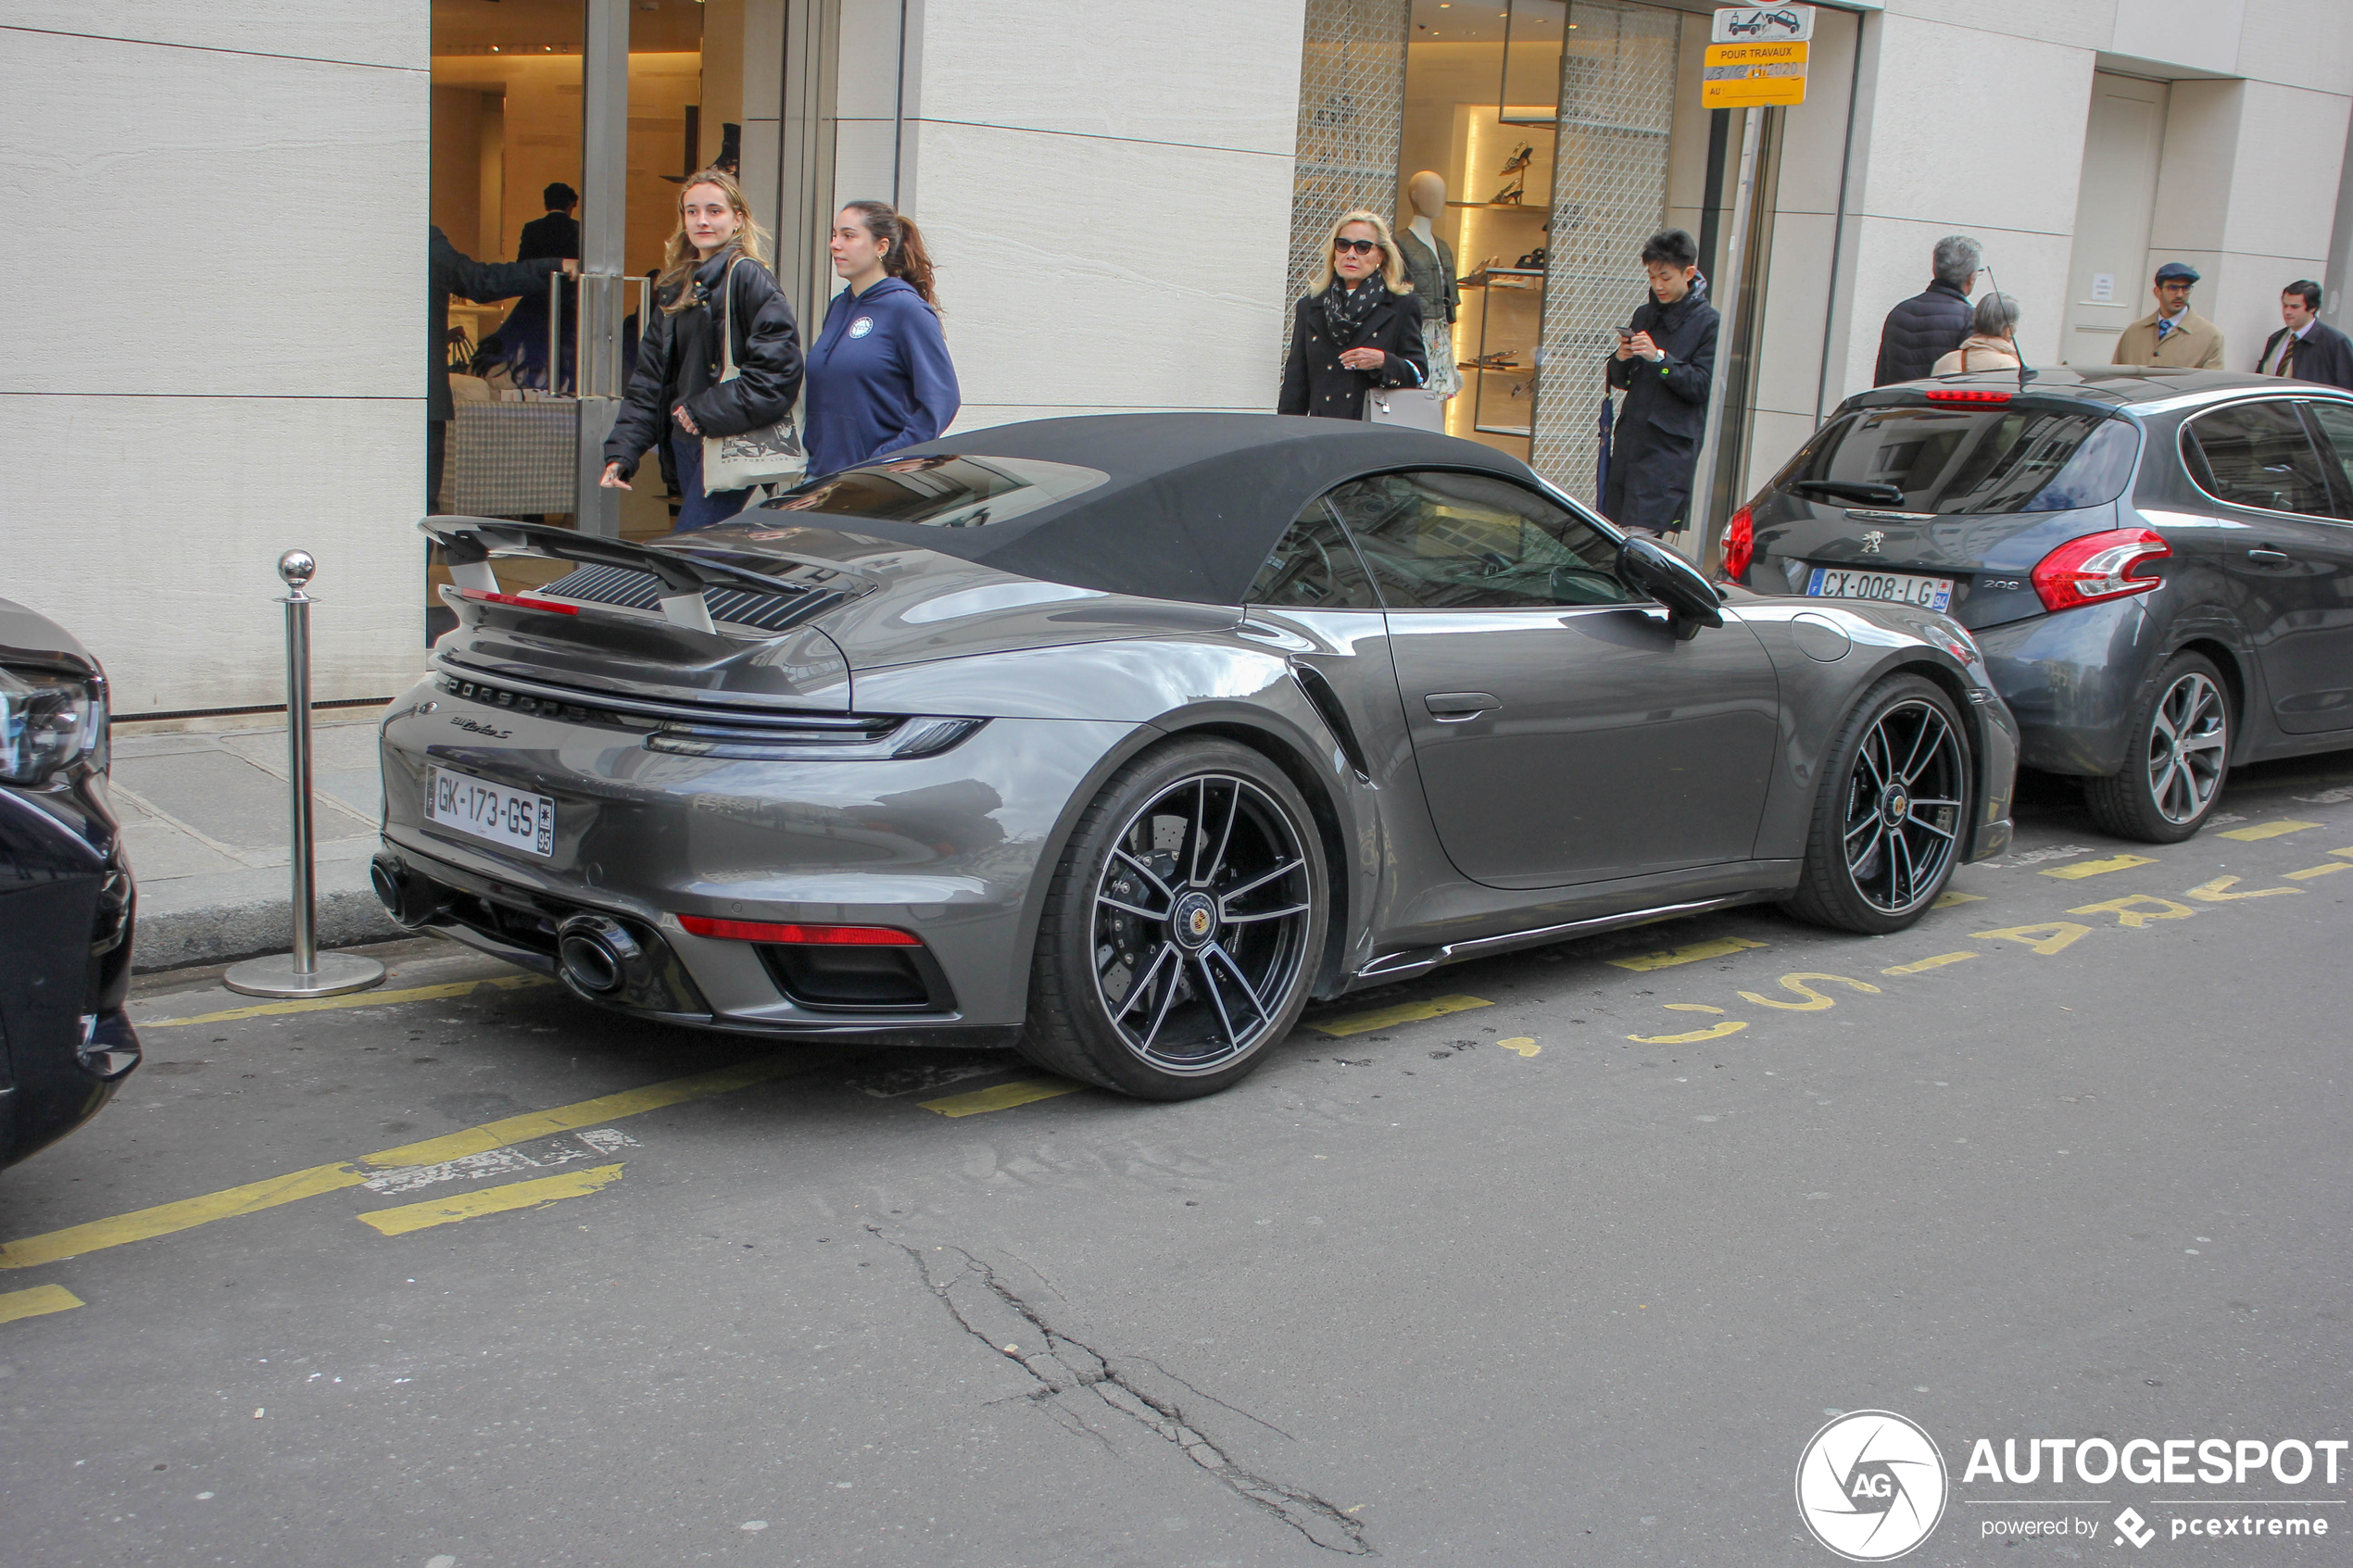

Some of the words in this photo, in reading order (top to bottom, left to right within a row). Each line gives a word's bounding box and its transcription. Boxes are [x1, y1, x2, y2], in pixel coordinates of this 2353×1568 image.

[1720, 49, 1747, 59] POUR
[1750, 47, 1793, 58] TRAVAUX
[1823, 571, 1933, 605] CX-008-LG
[1933, 595, 1947, 608] 94
[439, 776, 534, 838] GK-173-GS
[538, 831, 551, 851] 95
